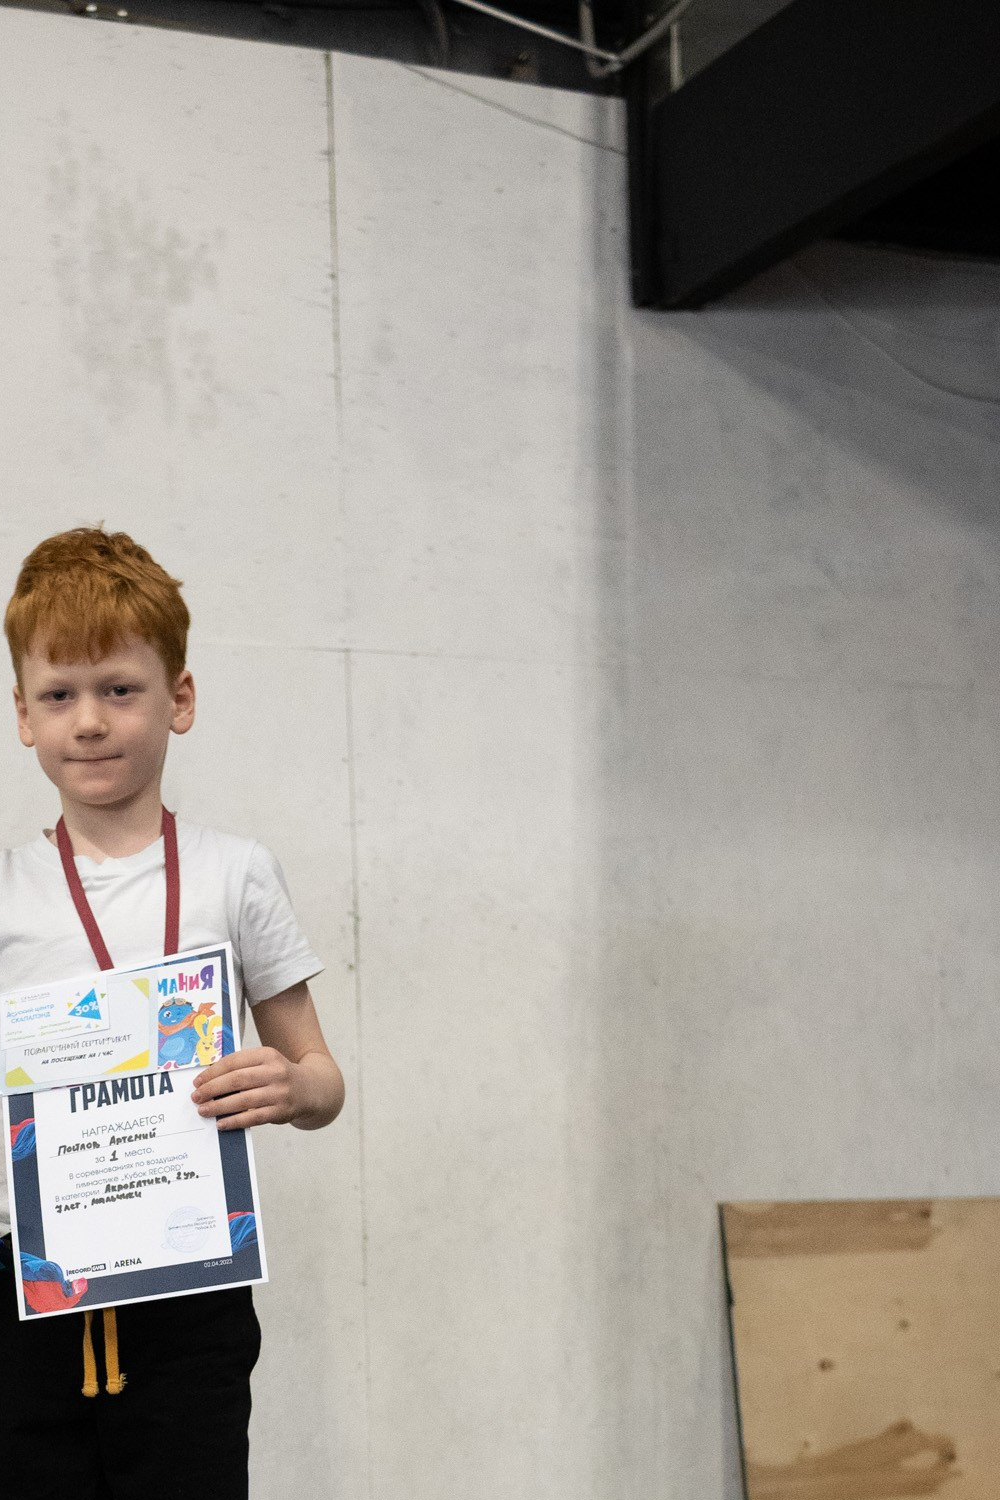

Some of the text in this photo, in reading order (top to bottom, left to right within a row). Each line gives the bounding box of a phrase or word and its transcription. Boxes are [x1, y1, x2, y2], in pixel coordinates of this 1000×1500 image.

[75, 1001, 100, 1016] 30%
[69, 1071, 174, 1113] ГРАМОТА
[81, 1114, 165, 1138] НАГРАЖДАЕТСЯ
[109, 1150, 118, 1162] 1
[146, 1152, 188, 1166] воздушной
[61, 1189, 100, 1201] категории
[114, 1257, 142, 1269] ARENA
[203, 1258, 233, 1268] 02.04.2023
